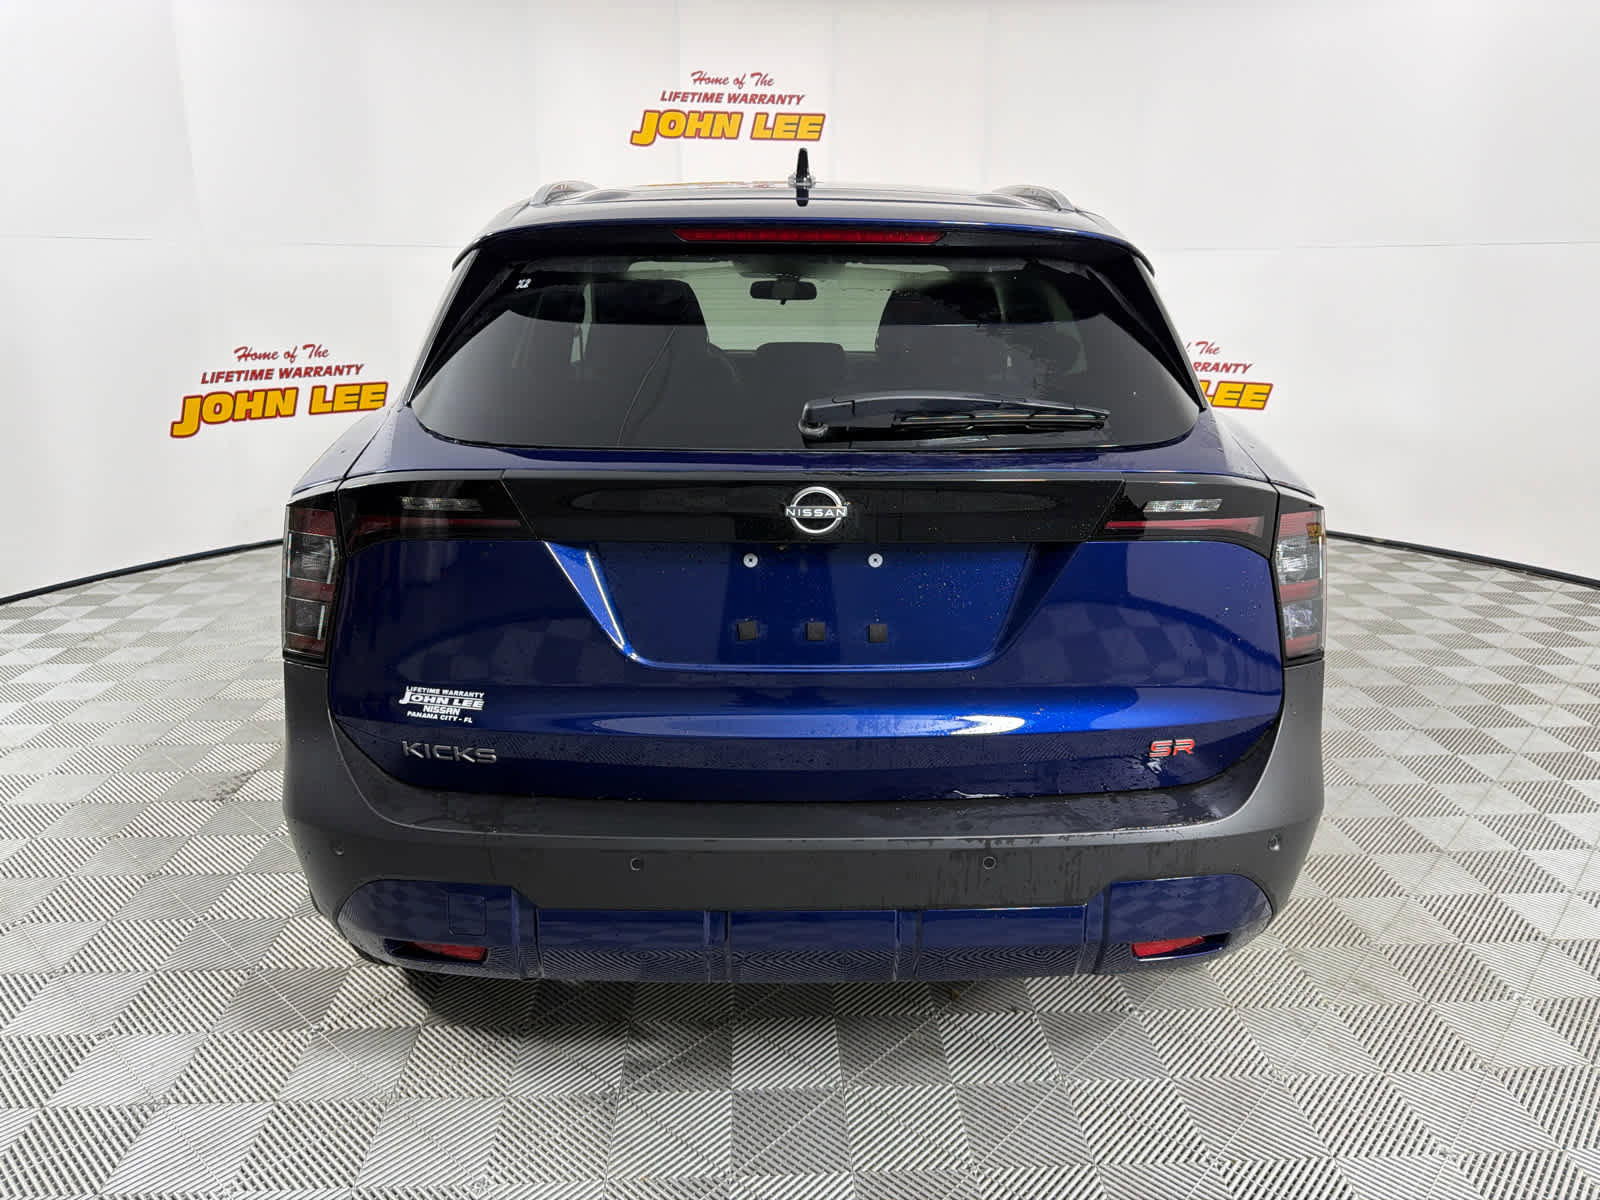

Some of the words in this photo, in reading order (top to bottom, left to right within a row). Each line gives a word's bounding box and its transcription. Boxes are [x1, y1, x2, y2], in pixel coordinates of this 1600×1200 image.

[690, 70, 730, 87] Home
[733, 73, 746, 89] of
[750, 72, 775, 87] The
[660, 90, 725, 104] LIFETIME
[727, 92, 806, 106] WARRANTY
[630, 109, 744, 147] JOHN
[750, 111, 827, 142] LEE
[233, 345, 280, 362] Home
[283, 345, 297, 364] of
[302, 343, 329, 360] The
[1195, 340, 1221, 355] The
[200, 367, 274, 385] LIFETIME
[278, 363, 365, 381] WARRANTY
[170, 386, 299, 439] JOHN
[308, 381, 389, 416] LEE
[785, 507, 848, 518] NISSAN
[398, 690, 450, 705] JOHN
[452, 697, 485, 709] LEE
[406, 686, 440, 694] LIFETIME
[442, 689, 484, 698] WARRANTY
[407, 711, 438, 720] PANAMA
[422, 706, 461, 715] NISSAN
[401, 740, 497, 764] KICKS
[1148, 738, 1195, 758] SR
